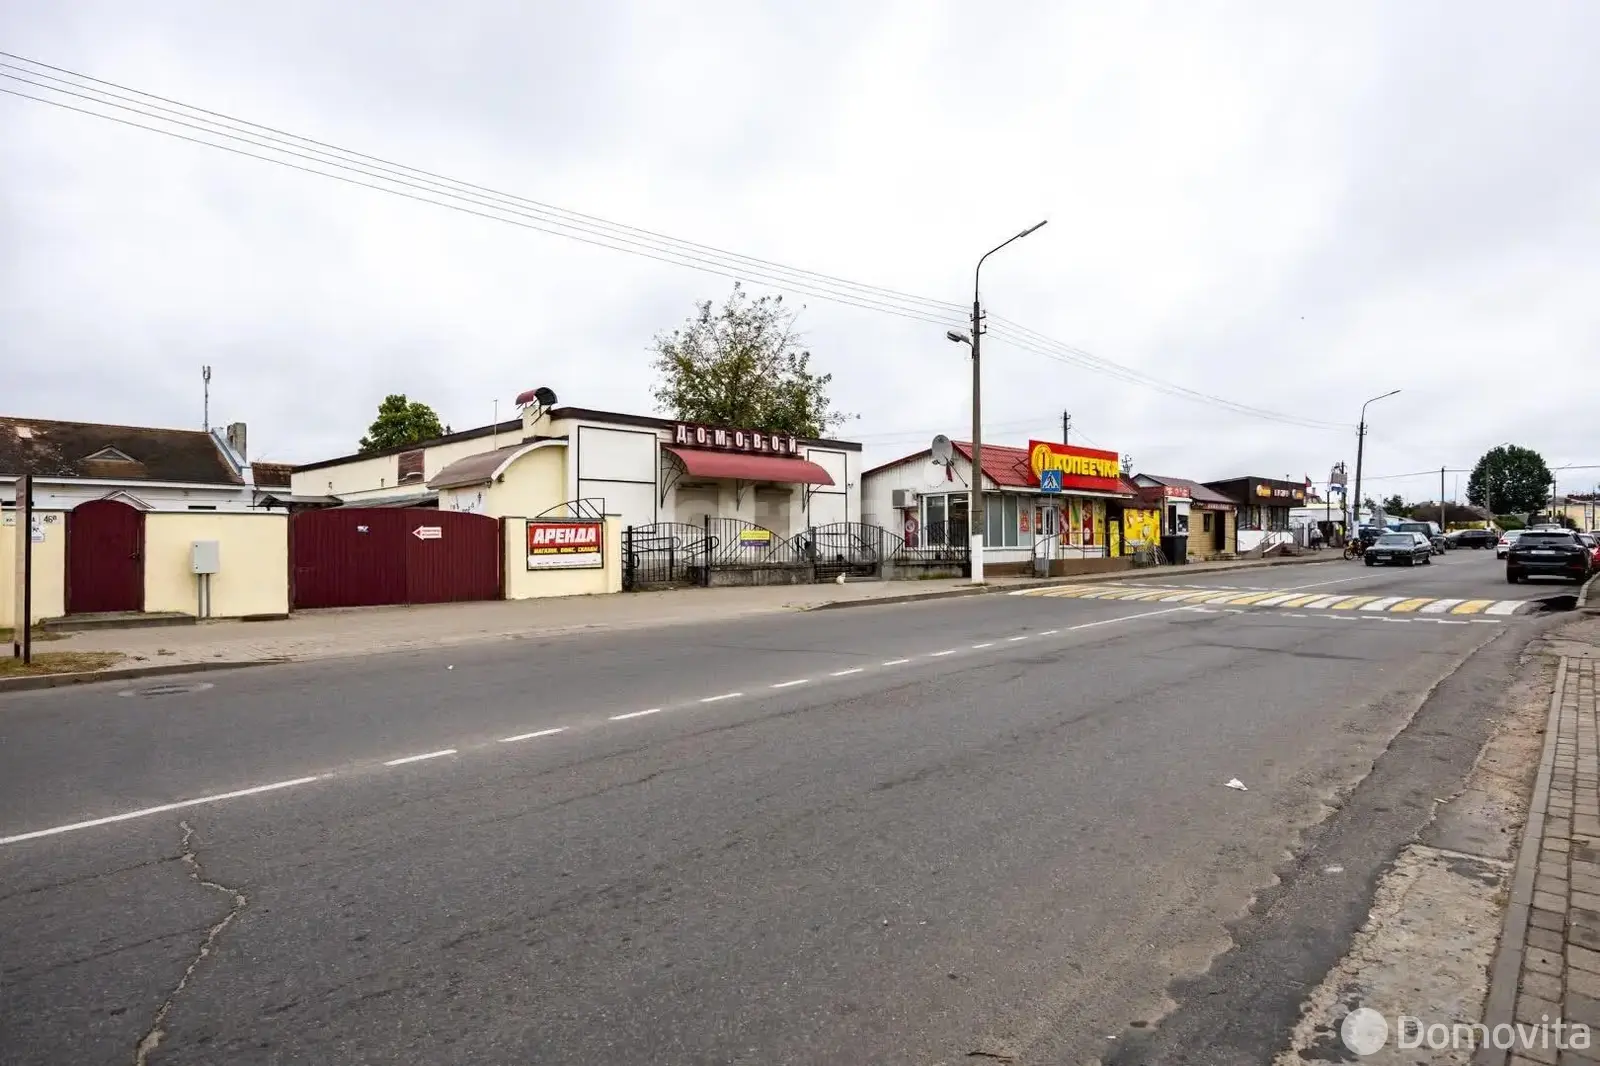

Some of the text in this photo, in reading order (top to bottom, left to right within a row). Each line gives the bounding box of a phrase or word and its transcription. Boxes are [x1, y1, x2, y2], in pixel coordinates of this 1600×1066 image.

[676, 424, 797, 452] ДОМОВОЙ
[1054, 455, 1120, 478] КОПЕЕЧКА
[533, 527, 597, 544] АРЕНДА
